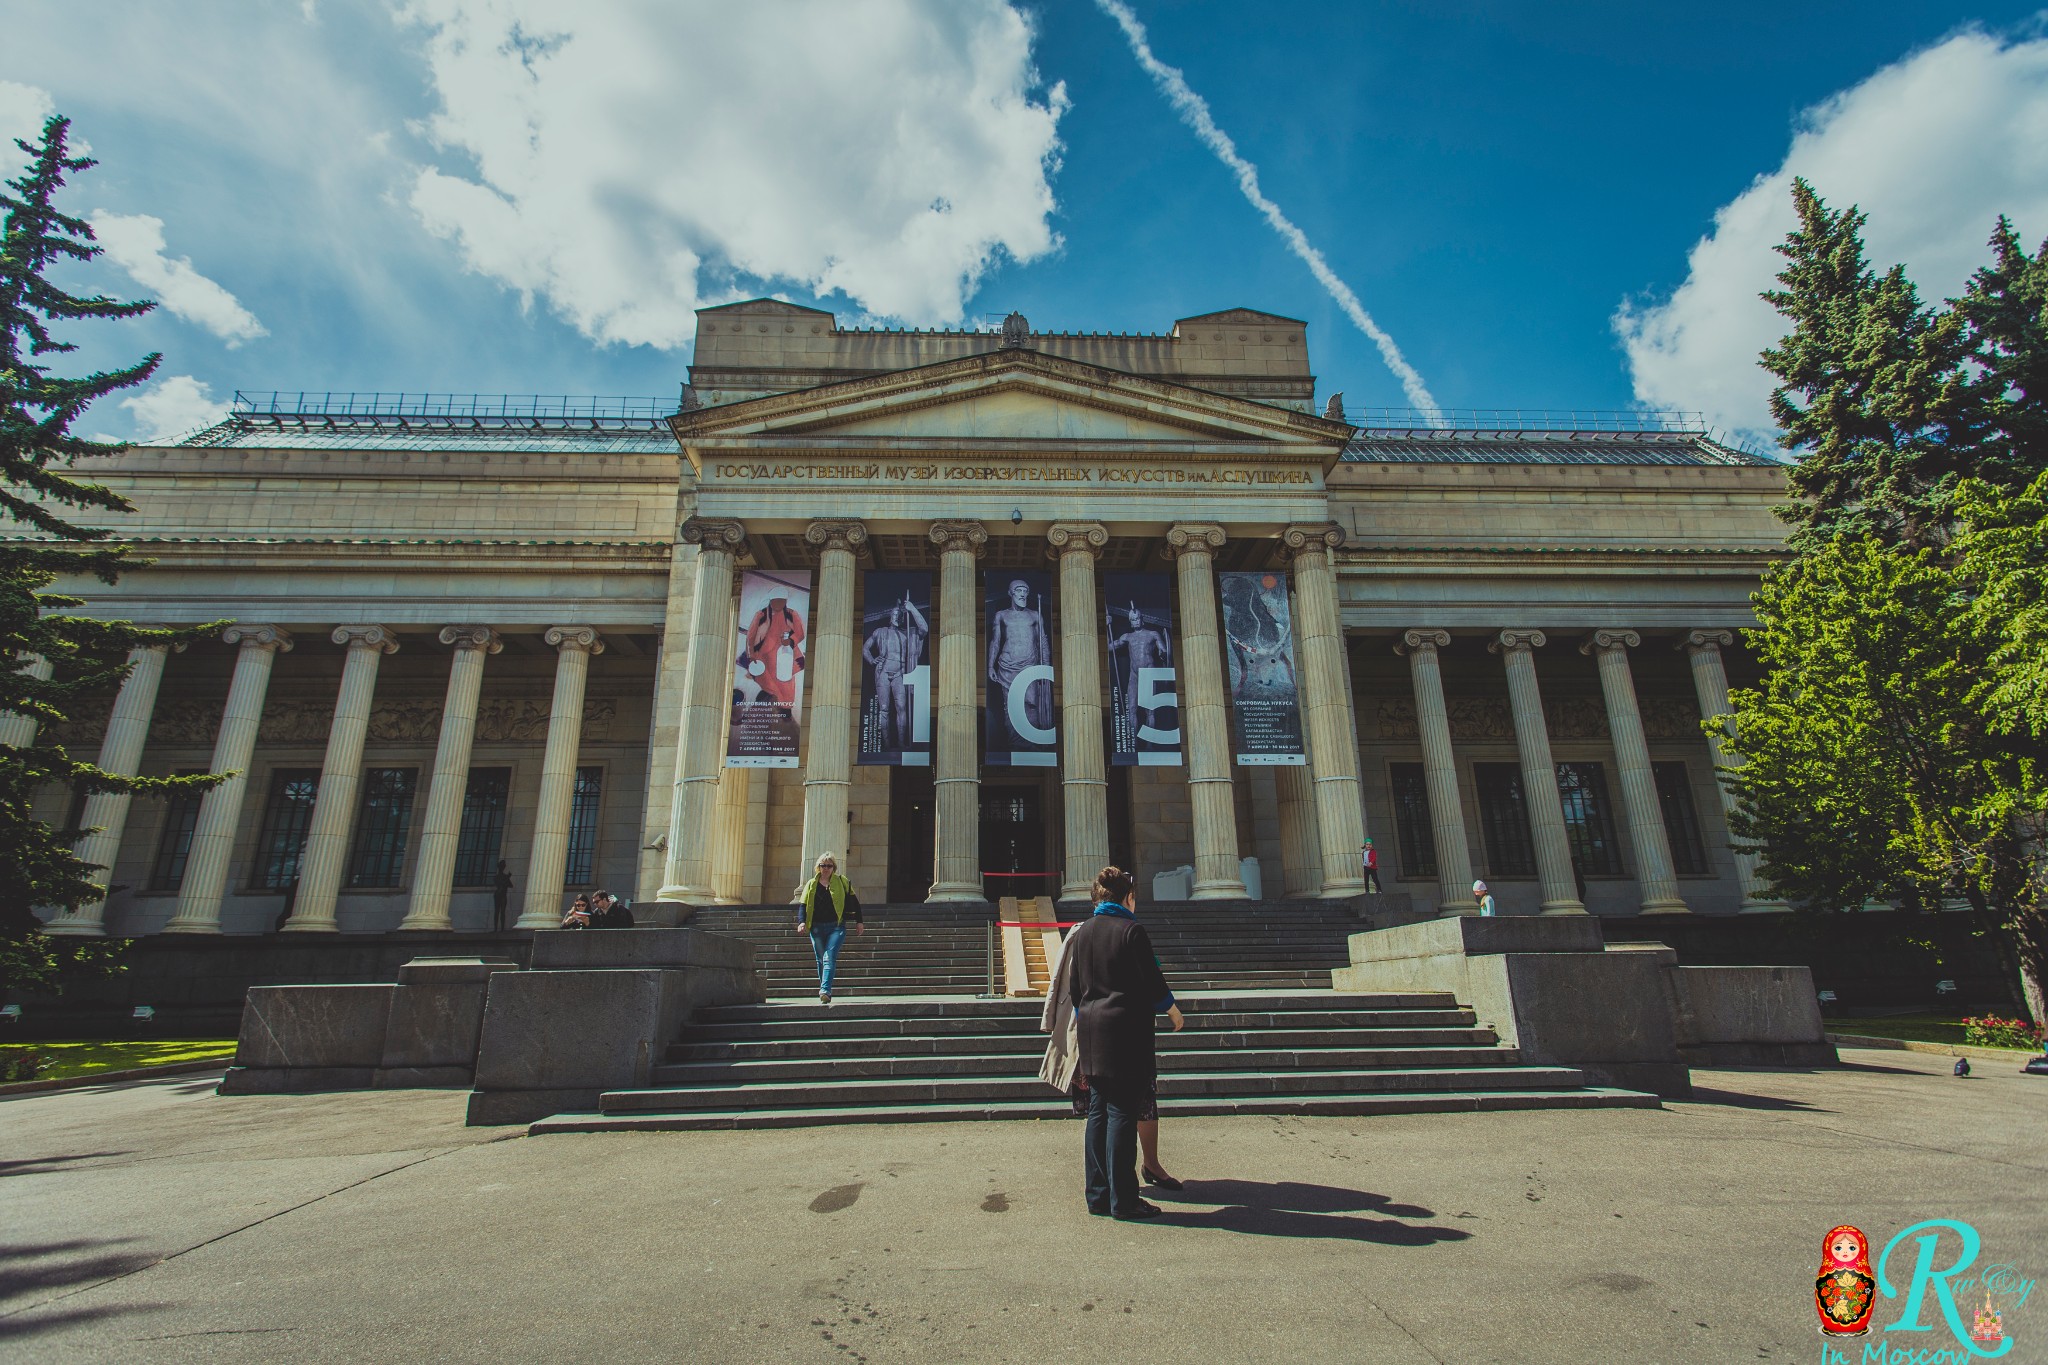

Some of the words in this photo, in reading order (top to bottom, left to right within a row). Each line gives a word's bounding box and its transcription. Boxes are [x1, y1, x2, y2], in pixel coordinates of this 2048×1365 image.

[715, 464, 880, 479] ГОСУДАРСТВЕННЫЙ
[884, 465, 938, 480] МУЗЕЙ
[943, 466, 1092, 481] ИЗОБРАЗИТЕЛЬНЫХ
[1097, 468, 1186, 483] ИСКУССТВ
[902, 664, 930, 743] 1
[1136, 667, 1180, 744] 5
